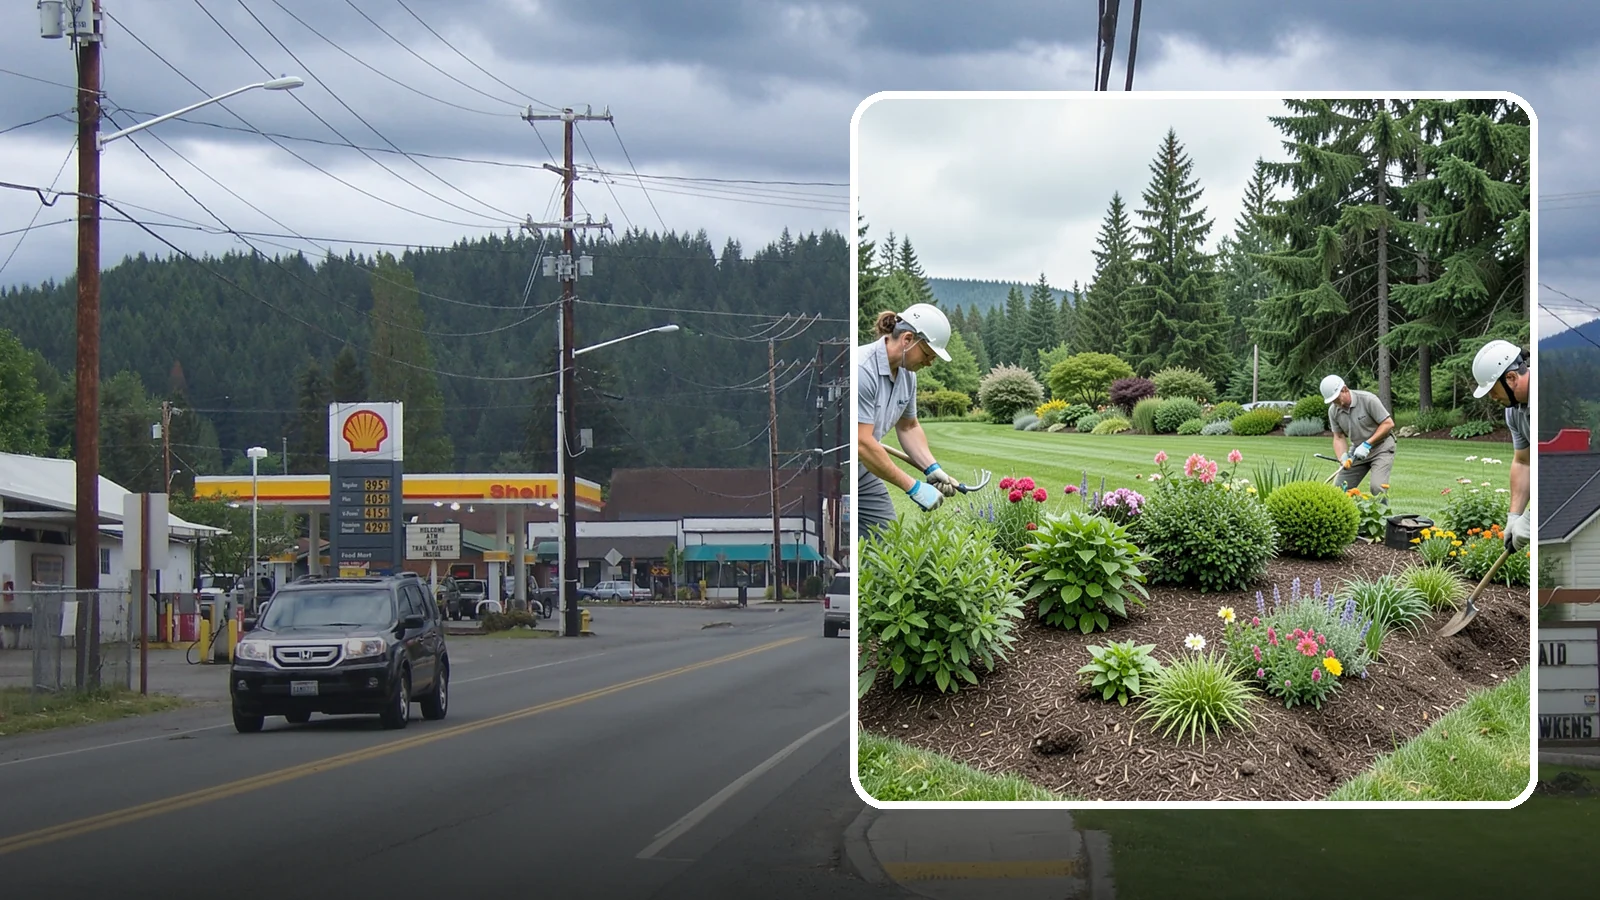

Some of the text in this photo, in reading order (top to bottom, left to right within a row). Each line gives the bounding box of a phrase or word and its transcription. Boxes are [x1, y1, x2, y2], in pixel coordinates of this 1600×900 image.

[365, 480, 384, 490] 395
[490, 484, 547, 499] Shell
[365, 494, 384, 504] 405
[365, 508, 384, 518] 415
[365, 522, 384, 532] 429
[1538, 643, 1567, 665] AID
